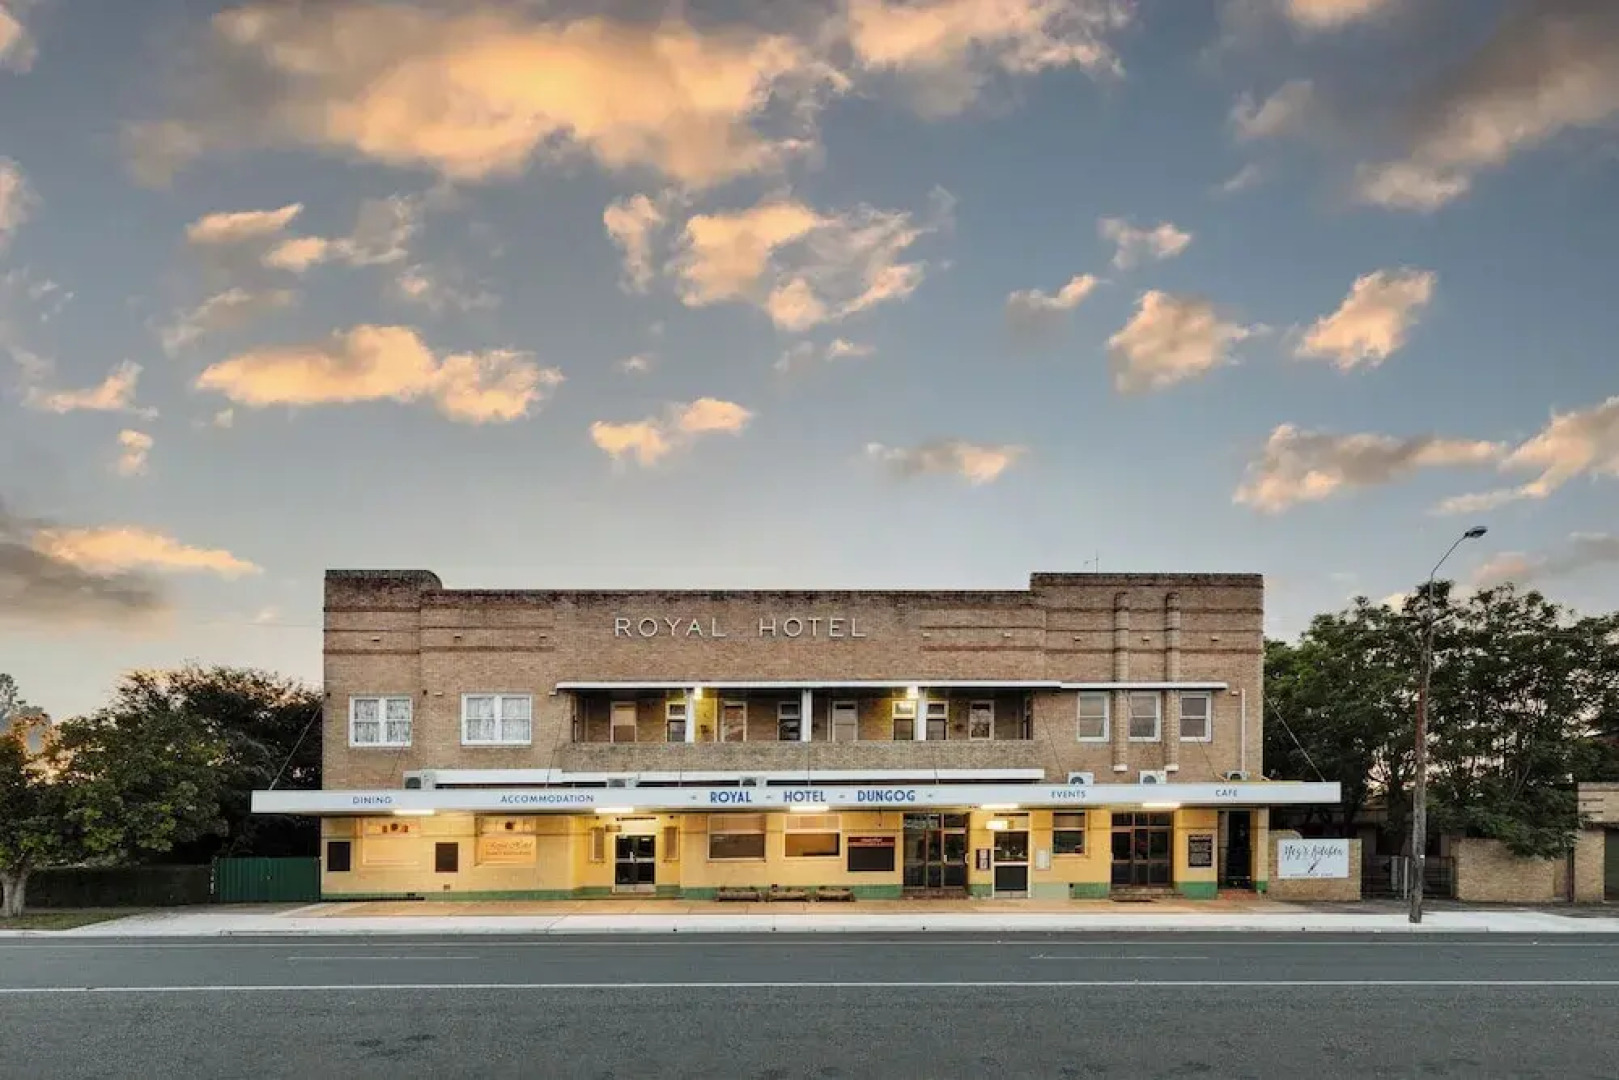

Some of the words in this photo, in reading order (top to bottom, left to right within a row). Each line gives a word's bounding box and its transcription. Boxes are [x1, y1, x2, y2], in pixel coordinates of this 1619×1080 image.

[614, 618, 727, 637] ROYAL
[758, 618, 867, 637] HOTEL
[709, 791, 753, 804] ROYAL
[783, 790, 827, 802] HOTEL
[857, 789, 916, 802] DUNGOG
[1051, 790, 1086, 799] EVENTS
[1215, 789, 1238, 798] CAFE
[352, 796, 392, 805] DINING
[500, 795, 595, 804] ACCOMMODATION
